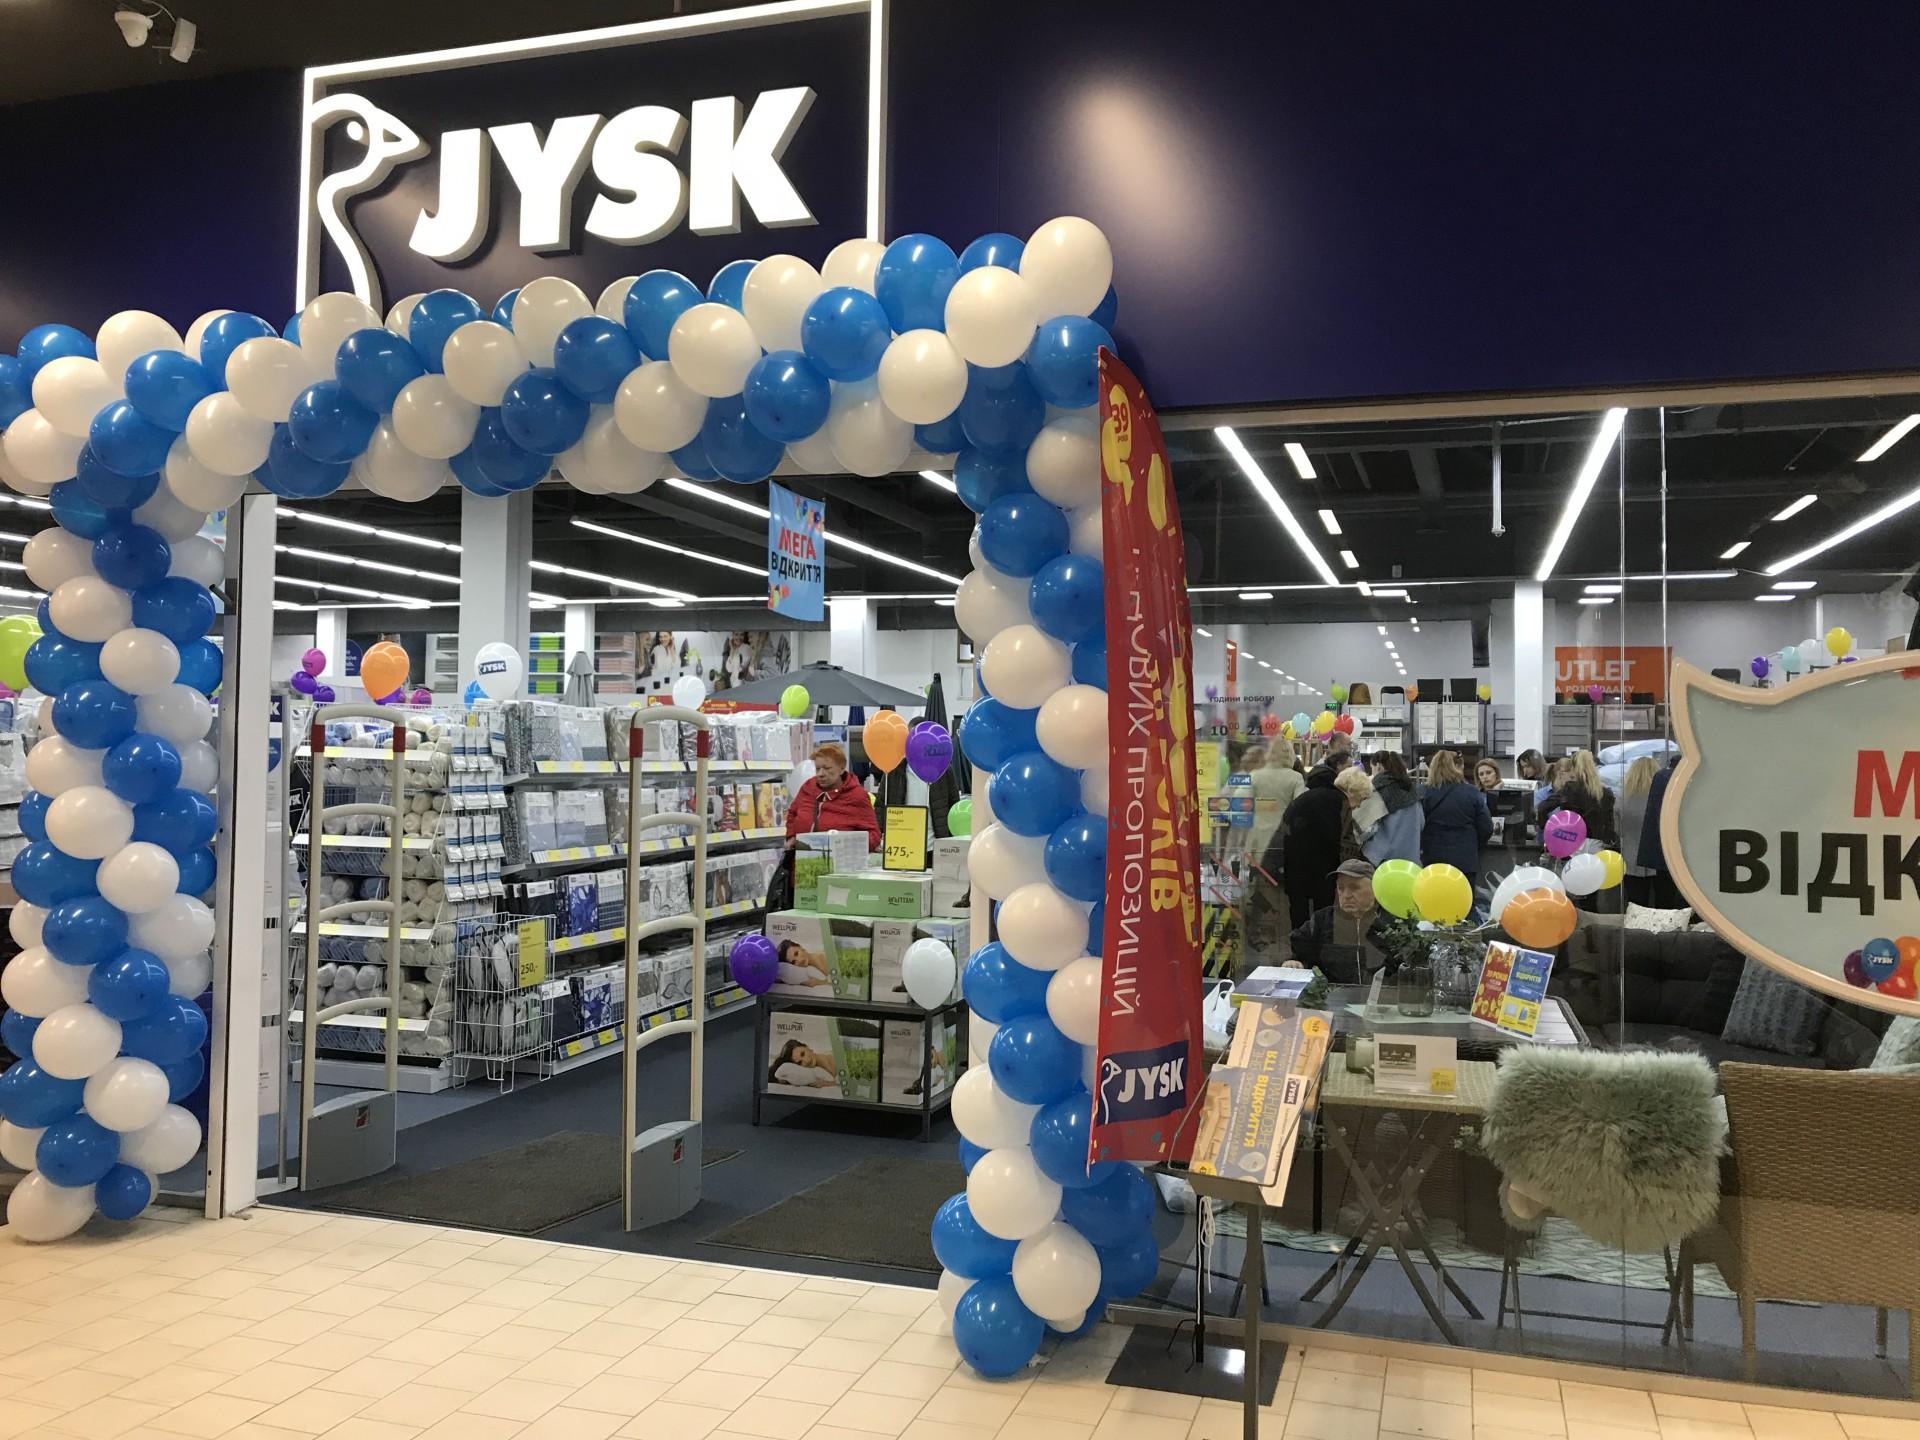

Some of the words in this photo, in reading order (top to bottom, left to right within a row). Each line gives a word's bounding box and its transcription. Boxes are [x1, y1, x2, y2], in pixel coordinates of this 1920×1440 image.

[409, 85, 818, 264] JYSK
[778, 527, 817, 560] МЕГА
[482, 662, 505, 673] JYSK
[1210, 695, 1240, 703] ГОДИНИ
[886, 846, 915, 858] 475,-
[1111, 746, 1149, 1017] ПРОПОЗИЦІЙ
[1719, 829, 1920, 916] ВІДК
[772, 924, 797, 932] WELLPUR
[520, 962, 539, 975] 250,-
[777, 1023, 803, 1032] WELLPUR
[1117, 1056, 1185, 1103] JYSK
[1287, 1083, 1298, 1103] JYSK
[1241, 1073, 1270, 1149] ВІДКРИТТЯ
